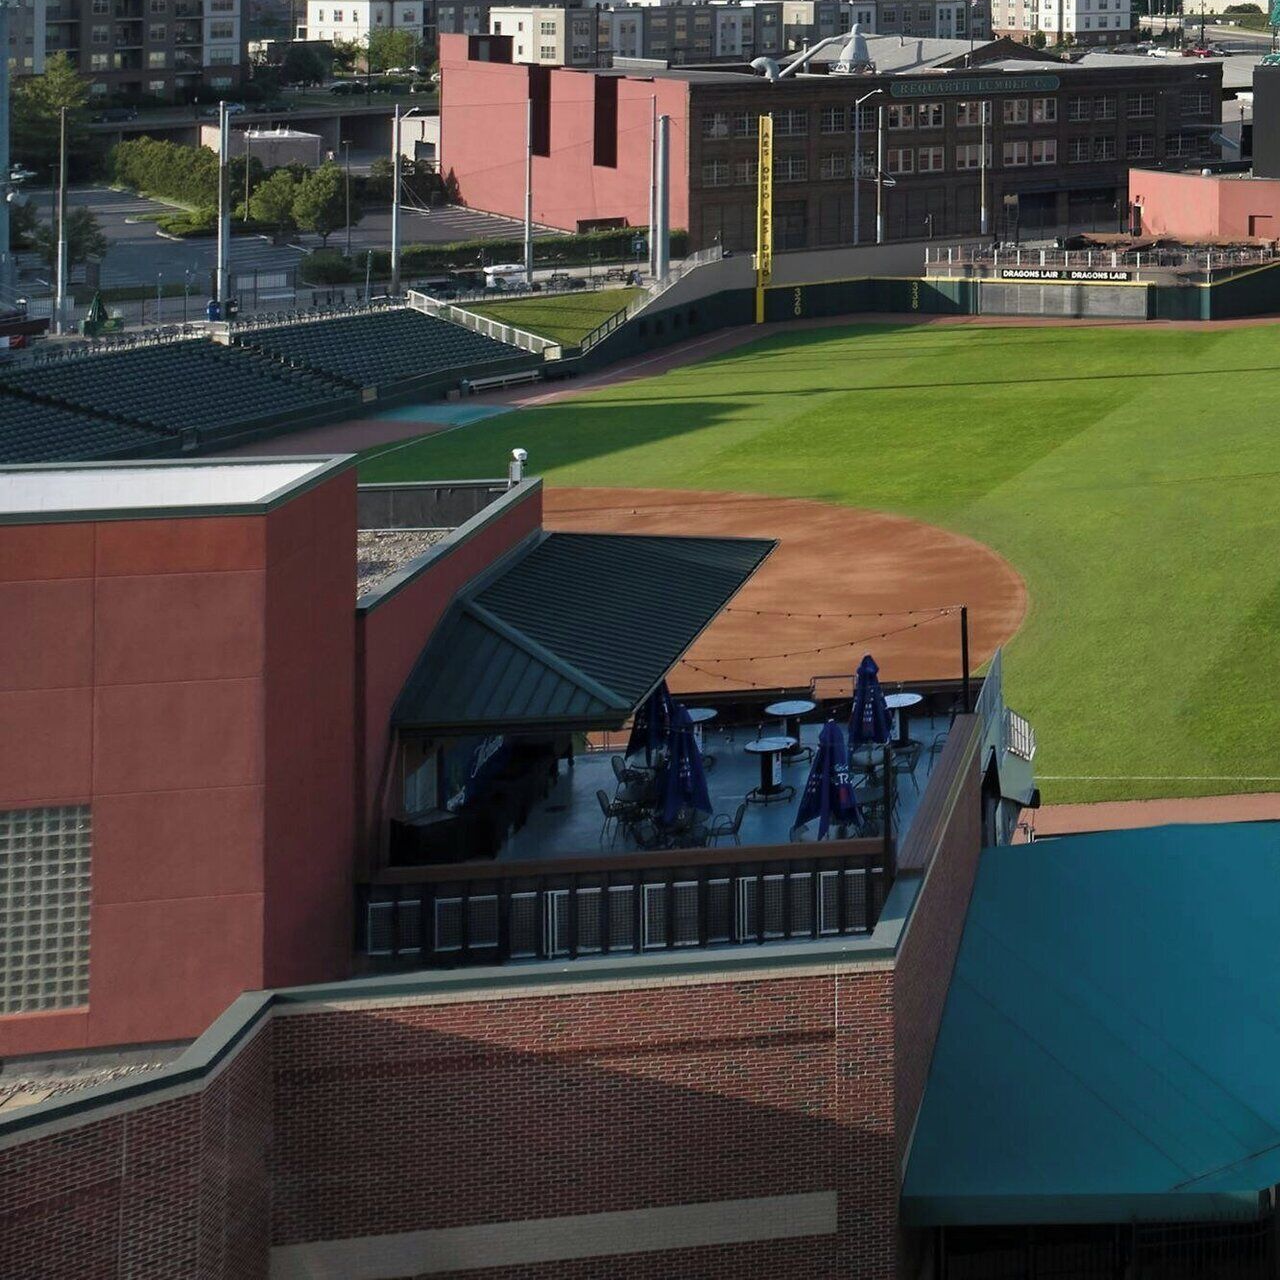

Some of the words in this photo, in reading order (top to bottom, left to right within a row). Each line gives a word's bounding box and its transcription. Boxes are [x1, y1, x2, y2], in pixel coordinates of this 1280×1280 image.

[900, 81, 970, 94] REQUARTH
[978, 79, 1028, 91] LUMBER
[1003, 270, 1039, 278] DRAGONS
[1071, 271, 1108, 279] DRAGONS
[1109, 272, 1127, 280] LAIR
